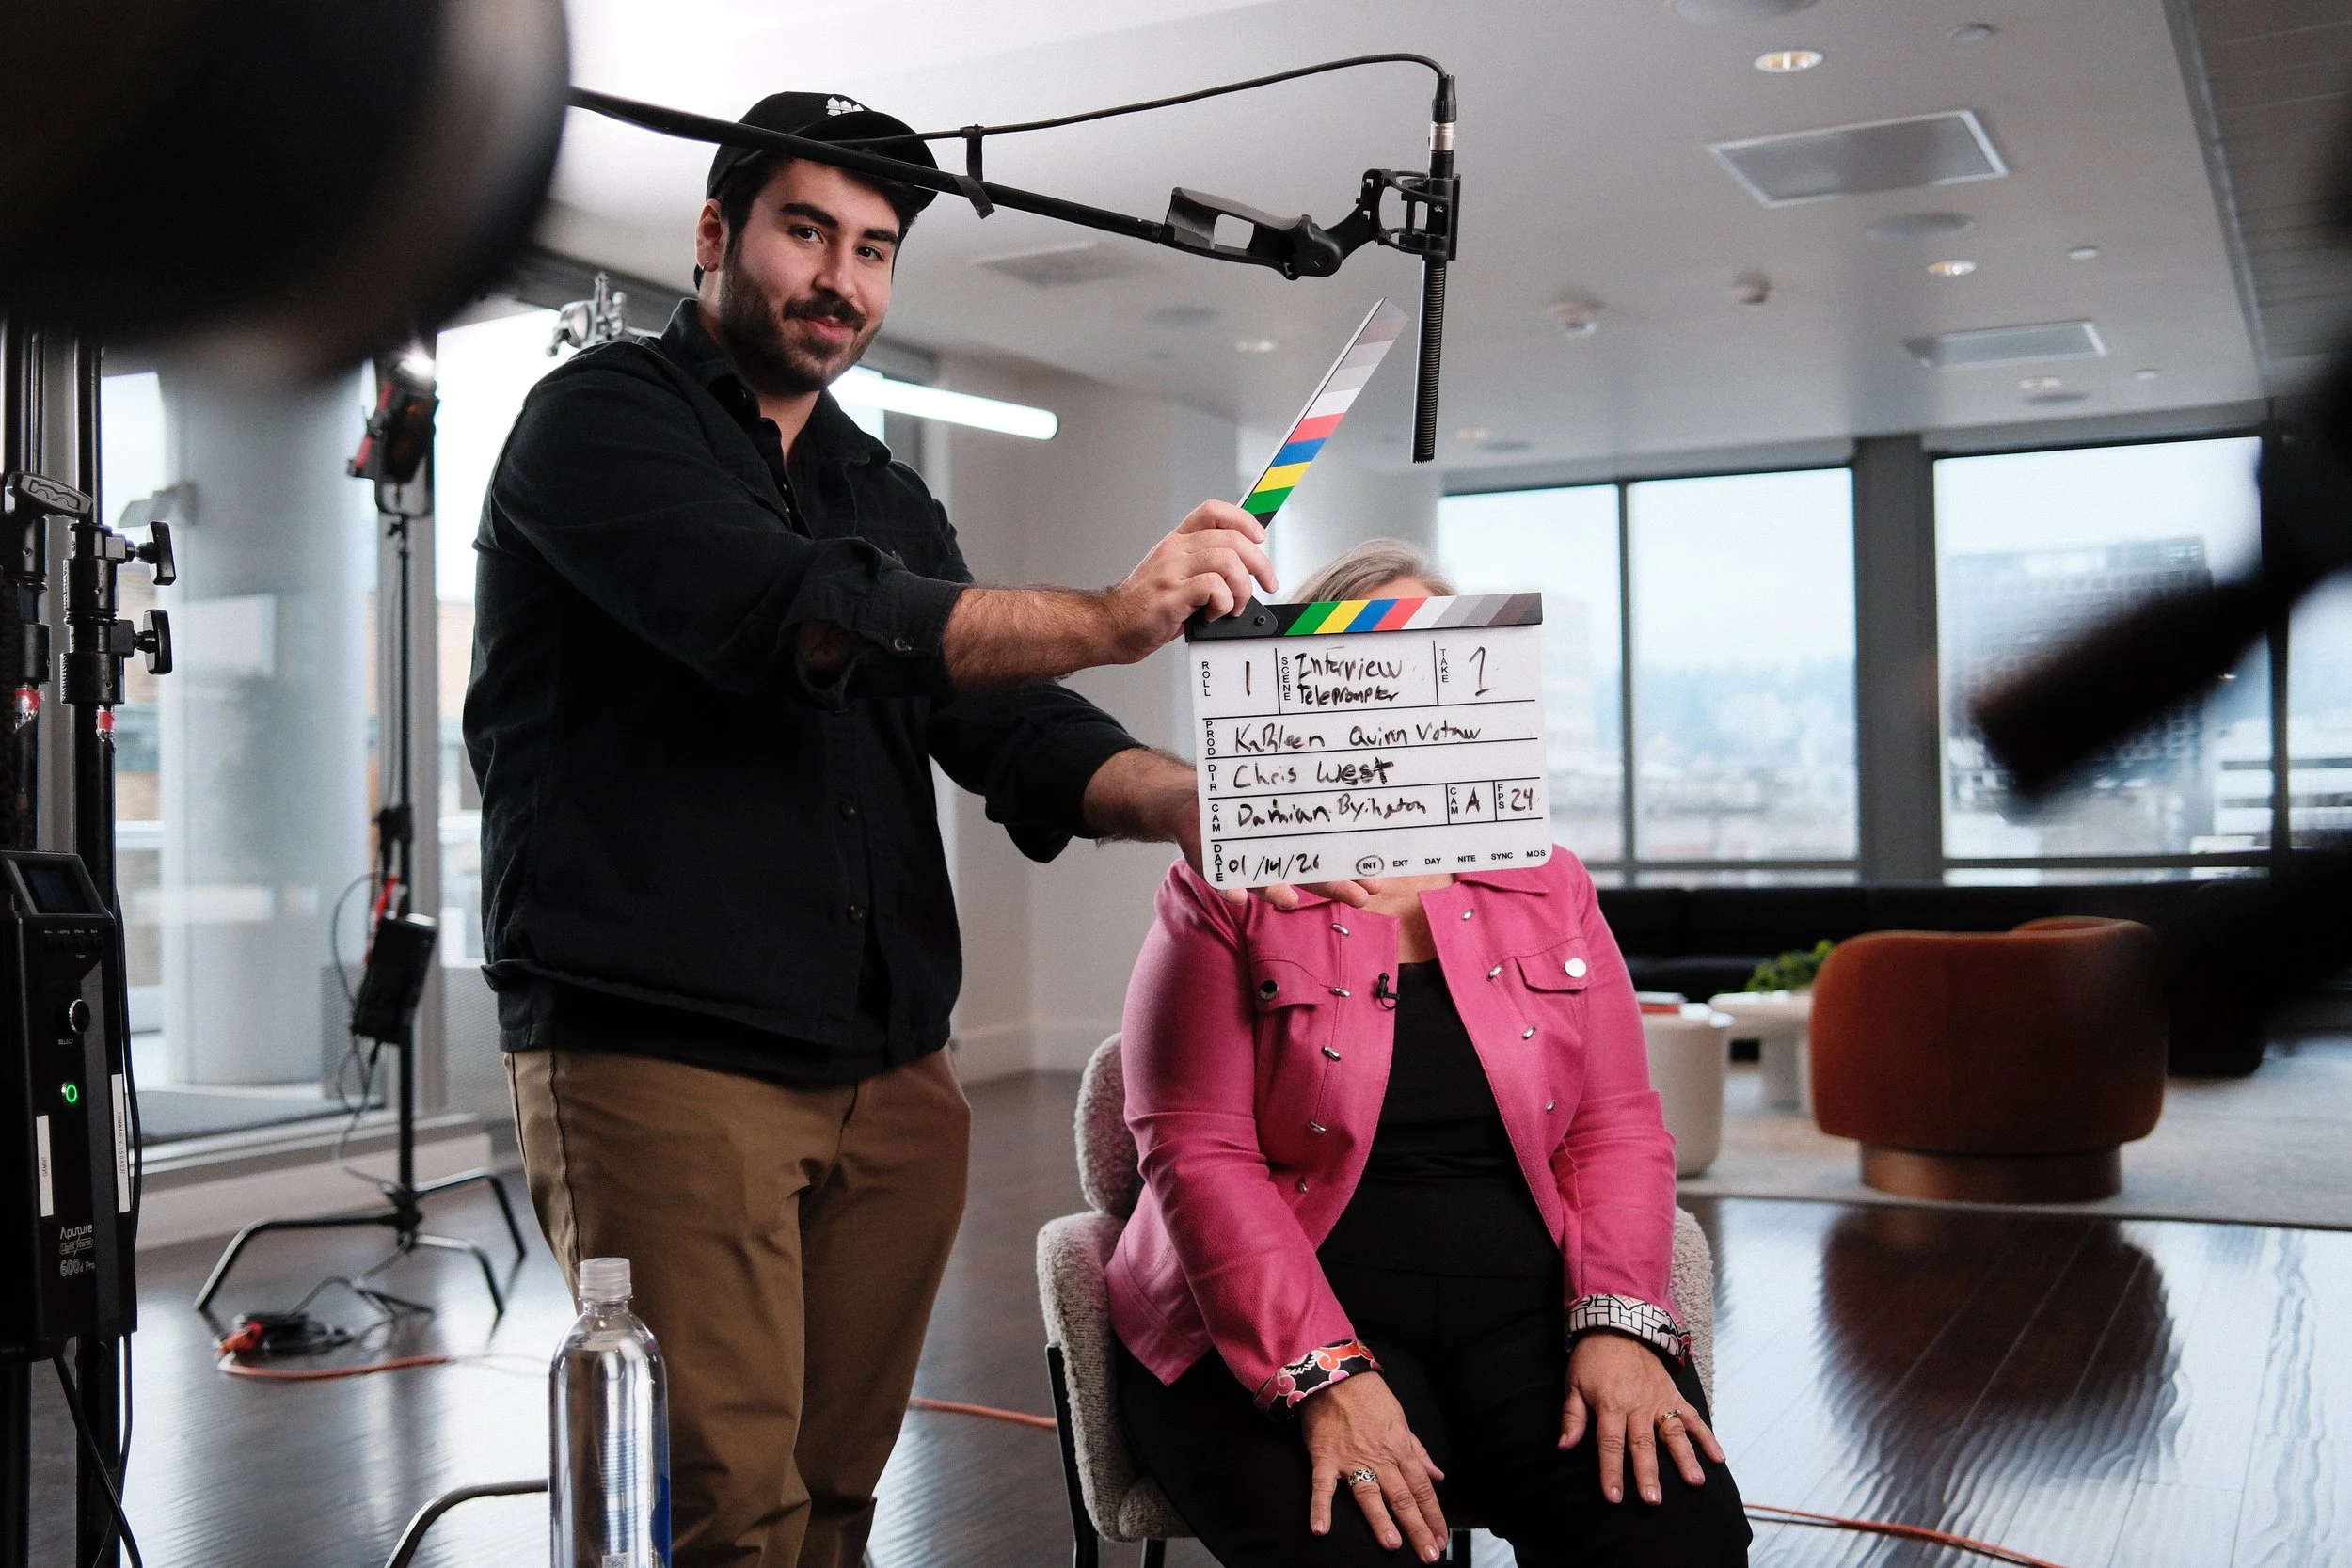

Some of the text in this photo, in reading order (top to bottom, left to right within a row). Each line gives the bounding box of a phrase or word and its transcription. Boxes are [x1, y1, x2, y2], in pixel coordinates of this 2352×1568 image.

[1201, 660, 1212, 697] ROLL
[1280, 657, 1292, 701] SCENE
[1295, 646, 1402, 684] Interview
[1439, 648, 1450, 683] TAKE
[1469, 646, 1493, 697] 1
[1205, 721, 1216, 756] PROD
[1348, 725, 1408, 747] Quinn
[1208, 764, 1218, 792] DIR
[1233, 756, 1394, 789] Chris West
[1449, 786, 1459, 815] CAM
[1465, 786, 1481, 815] A
[1497, 784, 1505, 810] FPS
[1511, 787, 1534, 812] 24
[1211, 804, 1222, 832] CAM
[1214, 844, 1224, 882] DATE
[1362, 849, 1546, 870] INT EXT DAY NITE SYNC MOS
